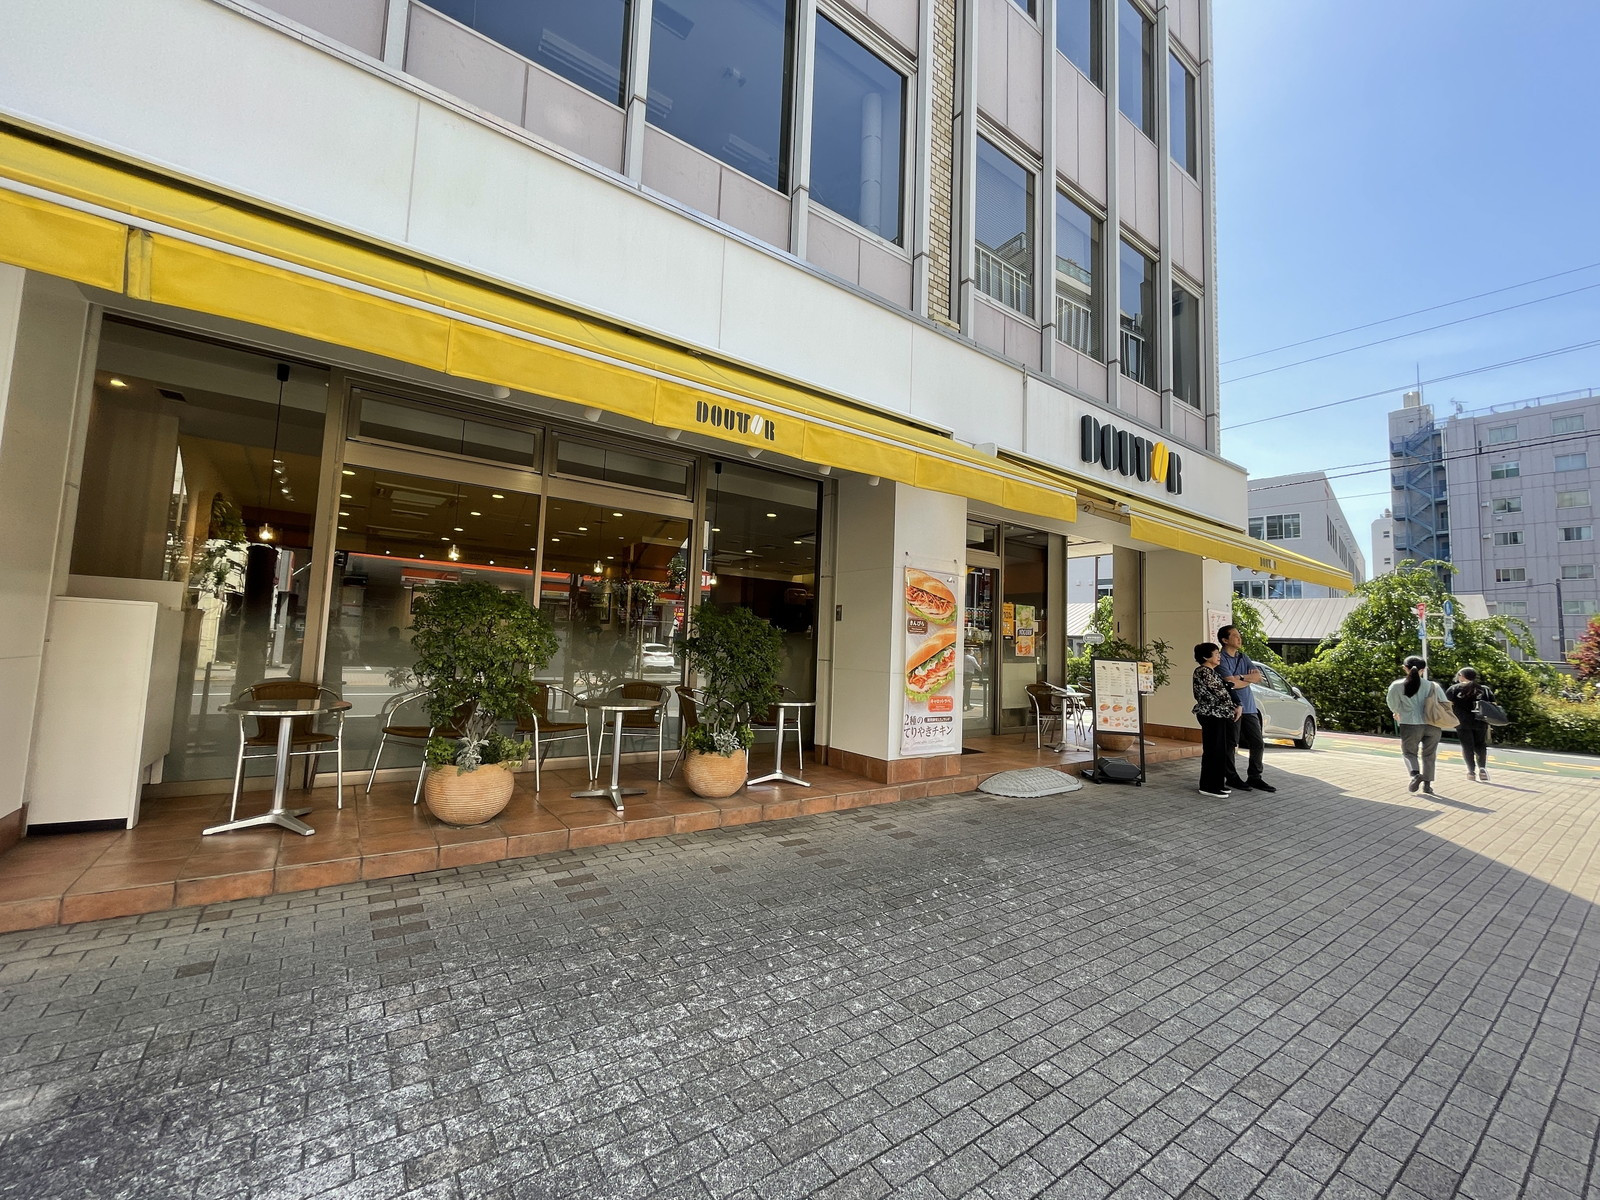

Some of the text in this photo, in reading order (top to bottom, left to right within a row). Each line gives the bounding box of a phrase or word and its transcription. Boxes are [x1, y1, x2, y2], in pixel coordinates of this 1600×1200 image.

[696, 400, 775, 441] DOUTOR
[1080, 414, 1182, 496] DOUTOR
[903, 725, 954, 739] てりやきチキン
[904, 713, 924, 726] 2種の
